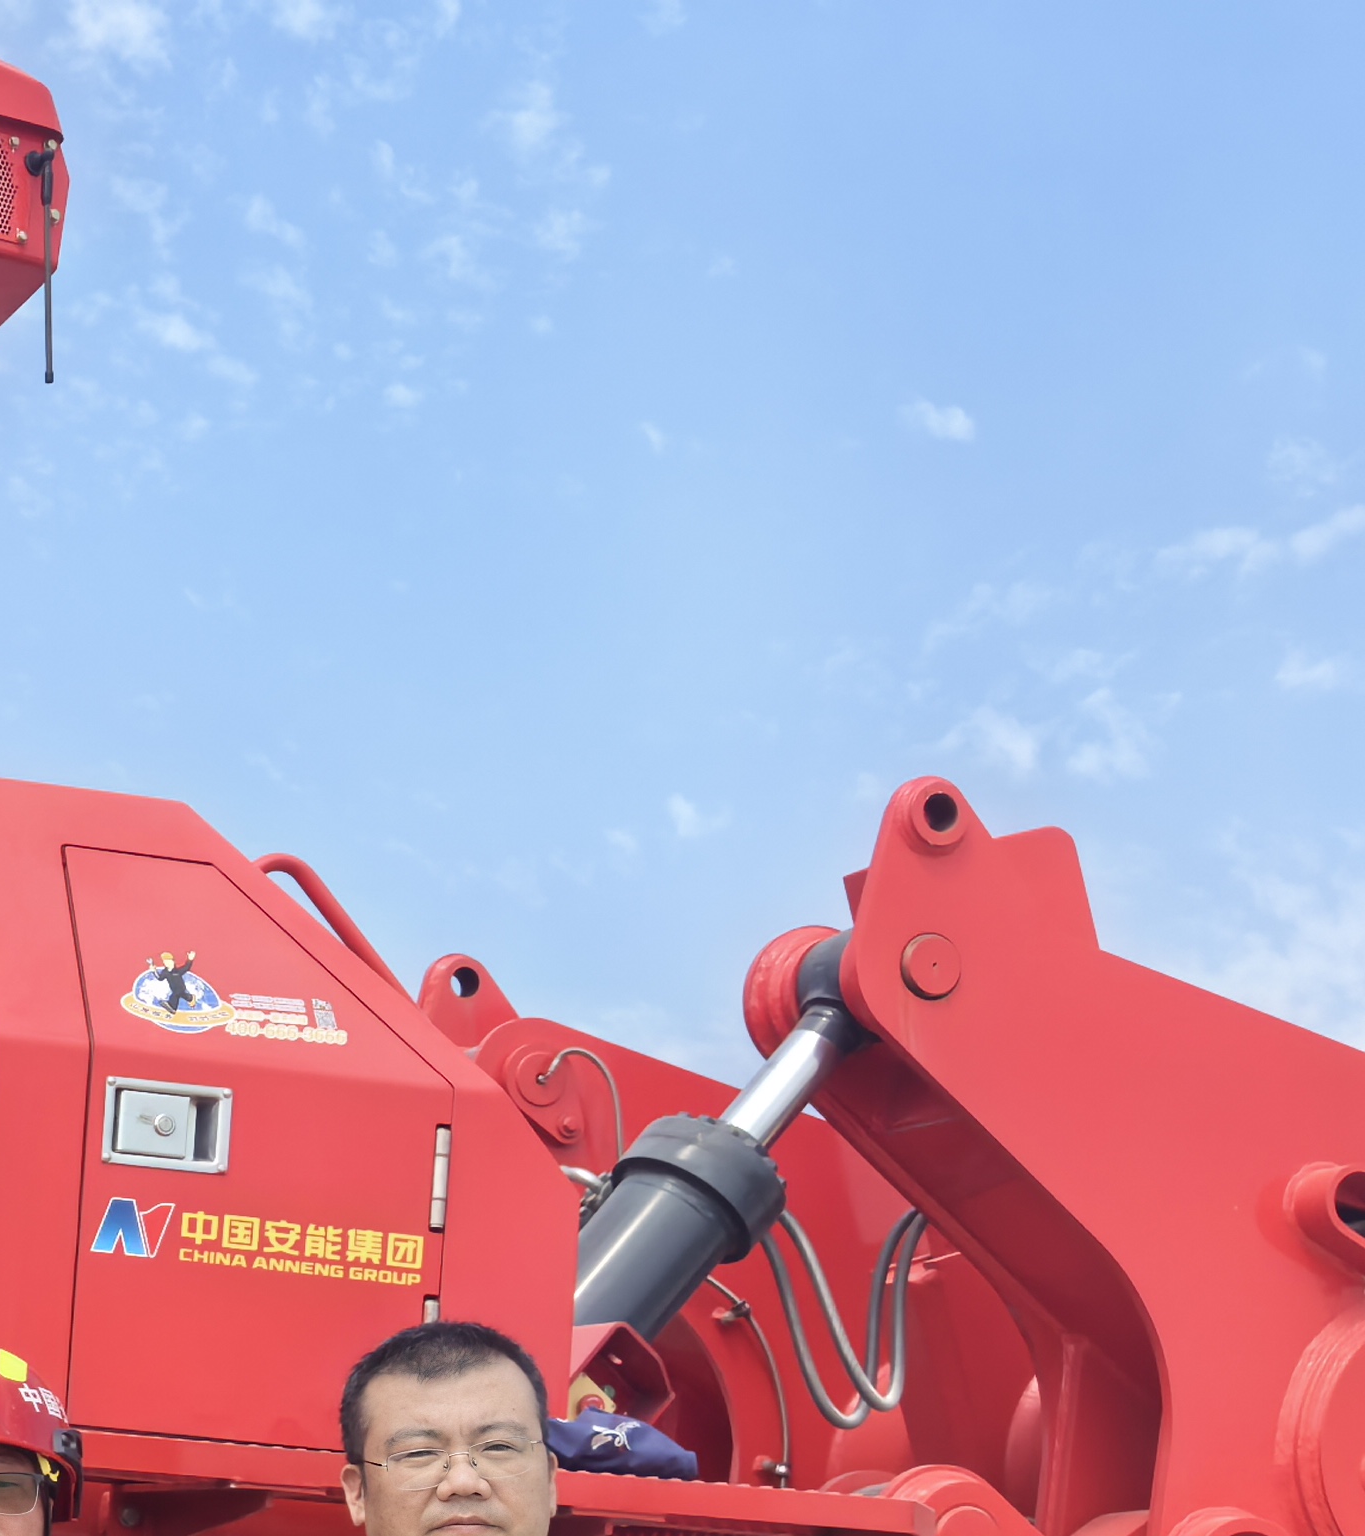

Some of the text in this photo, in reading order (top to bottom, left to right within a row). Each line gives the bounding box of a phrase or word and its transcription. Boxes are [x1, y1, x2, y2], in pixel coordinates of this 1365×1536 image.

[180, 1211, 424, 1270] 中国安能集团
[178, 1248, 422, 1287] CHINA ANNENG GROUP
